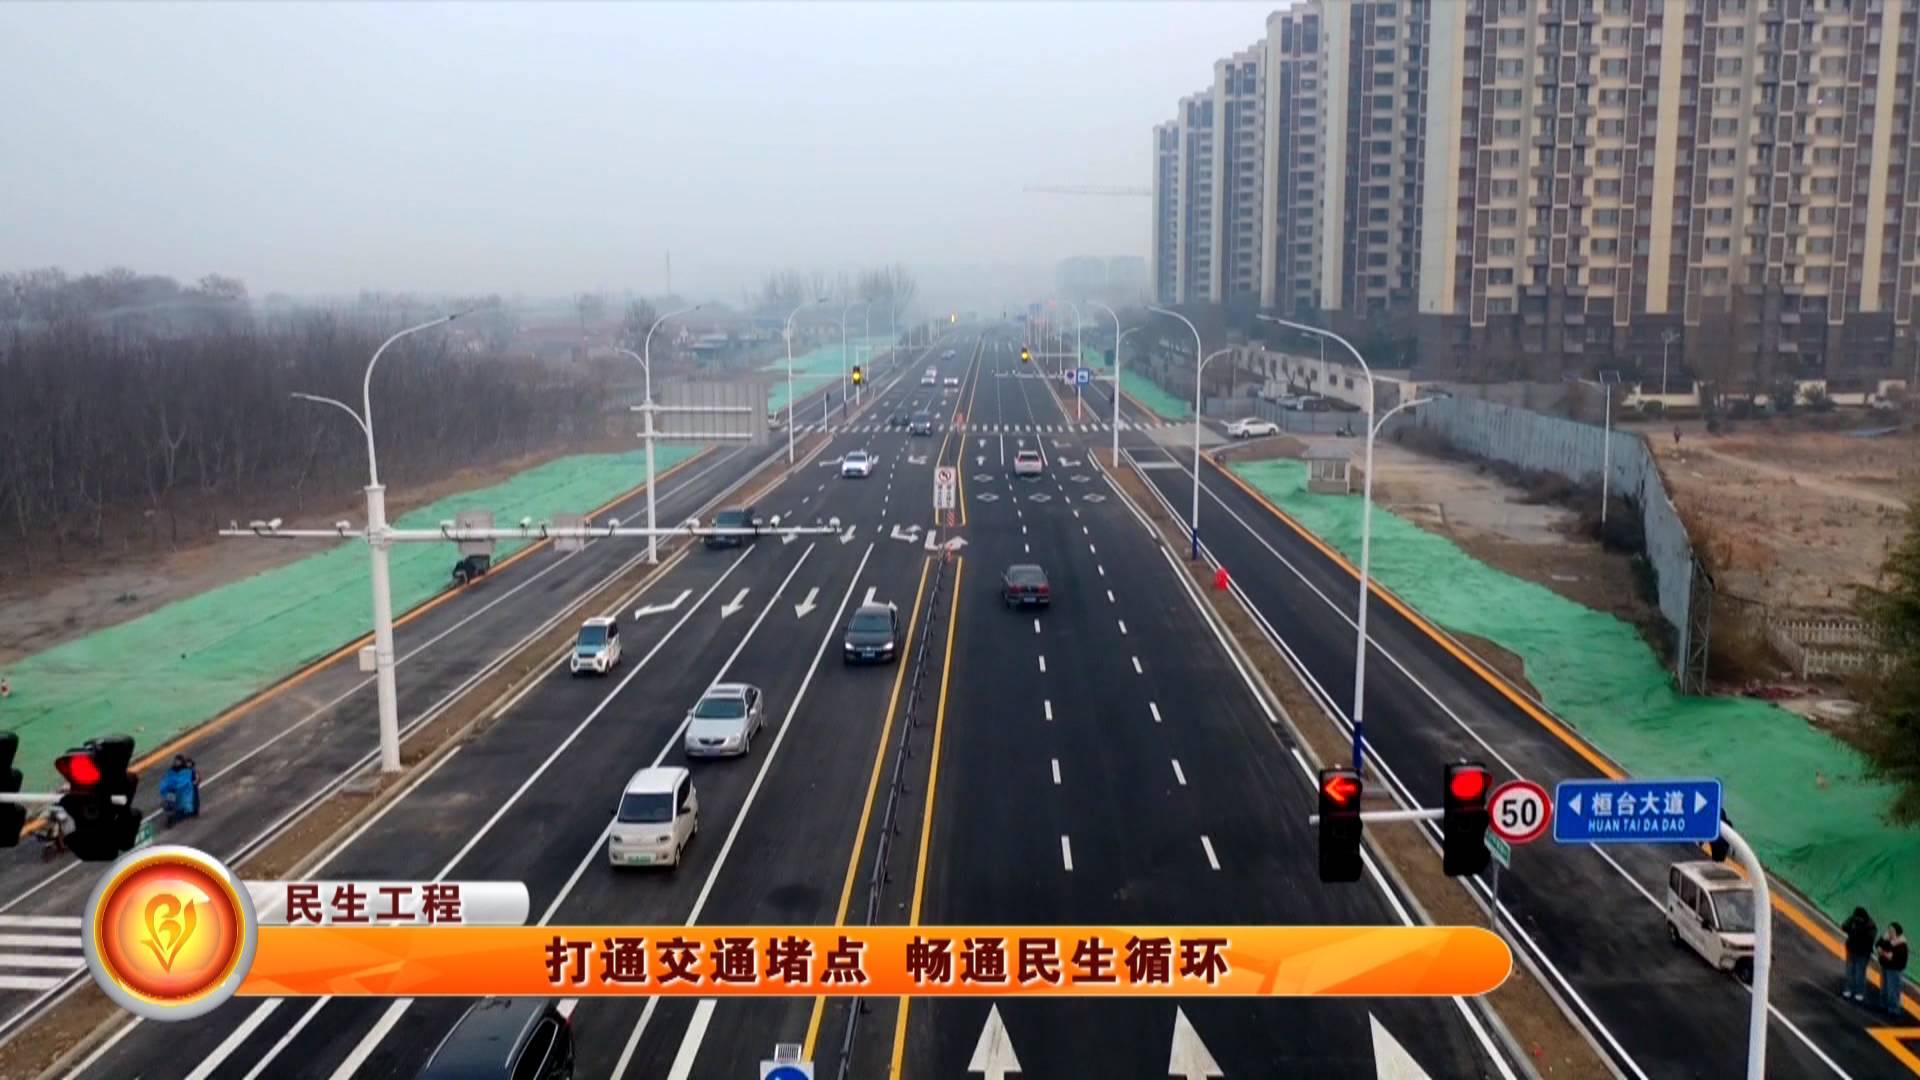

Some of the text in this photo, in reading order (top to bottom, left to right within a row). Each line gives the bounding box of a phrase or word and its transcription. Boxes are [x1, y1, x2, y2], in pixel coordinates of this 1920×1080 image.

[1502, 799, 1537, 828] 50
[1592, 791, 1685, 816] 桓台大道
[1588, 817, 1685, 832] HUAN TAI DA DAO
